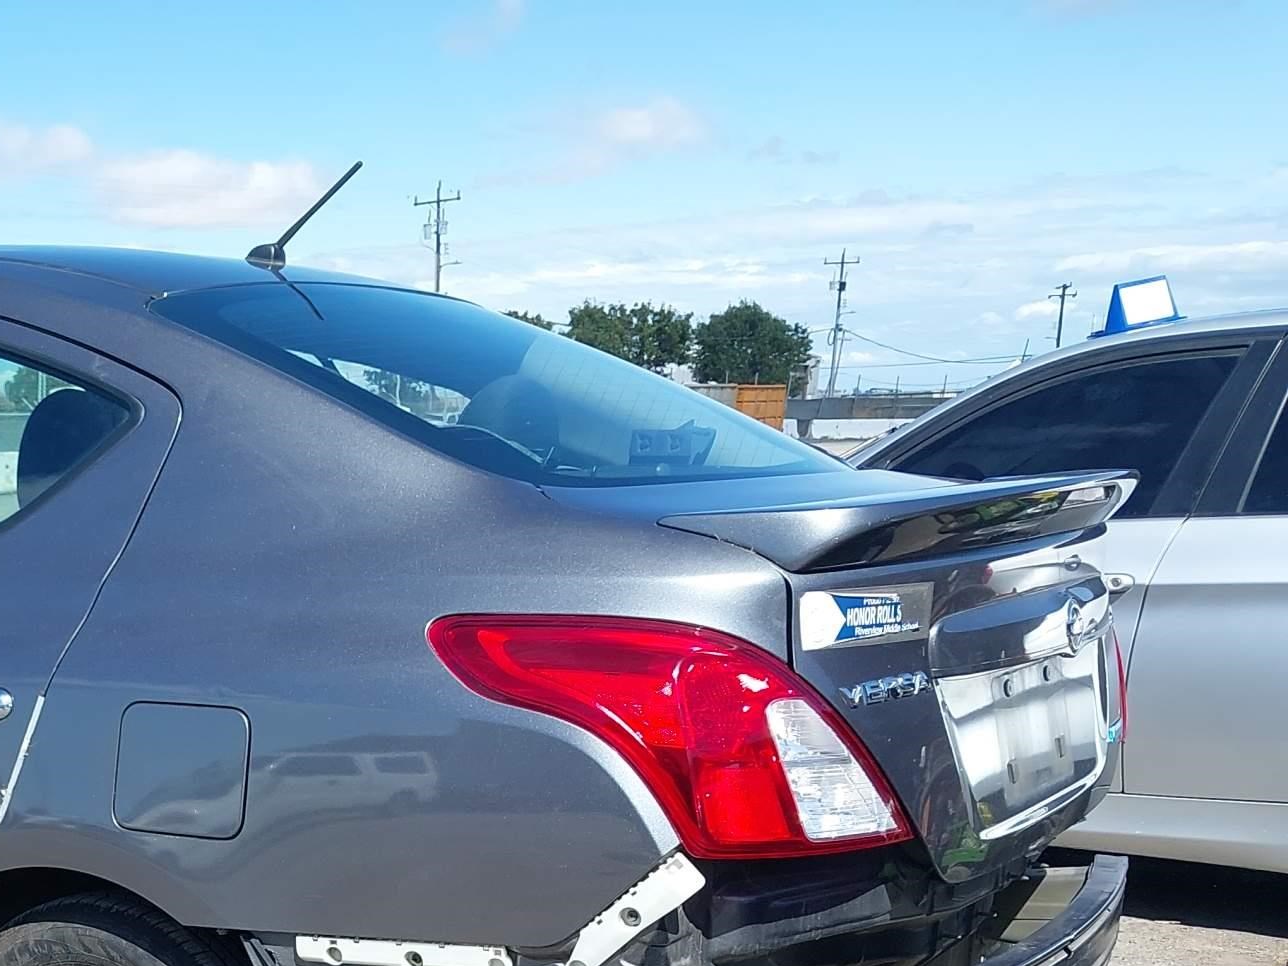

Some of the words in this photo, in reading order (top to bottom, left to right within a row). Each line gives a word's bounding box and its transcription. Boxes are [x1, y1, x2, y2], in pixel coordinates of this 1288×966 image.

[846, 606, 876, 627] HONOR
[876, 604, 896, 624] ROLL
[902, 620, 919, 631] School
[838, 670, 930, 707] VERSA
